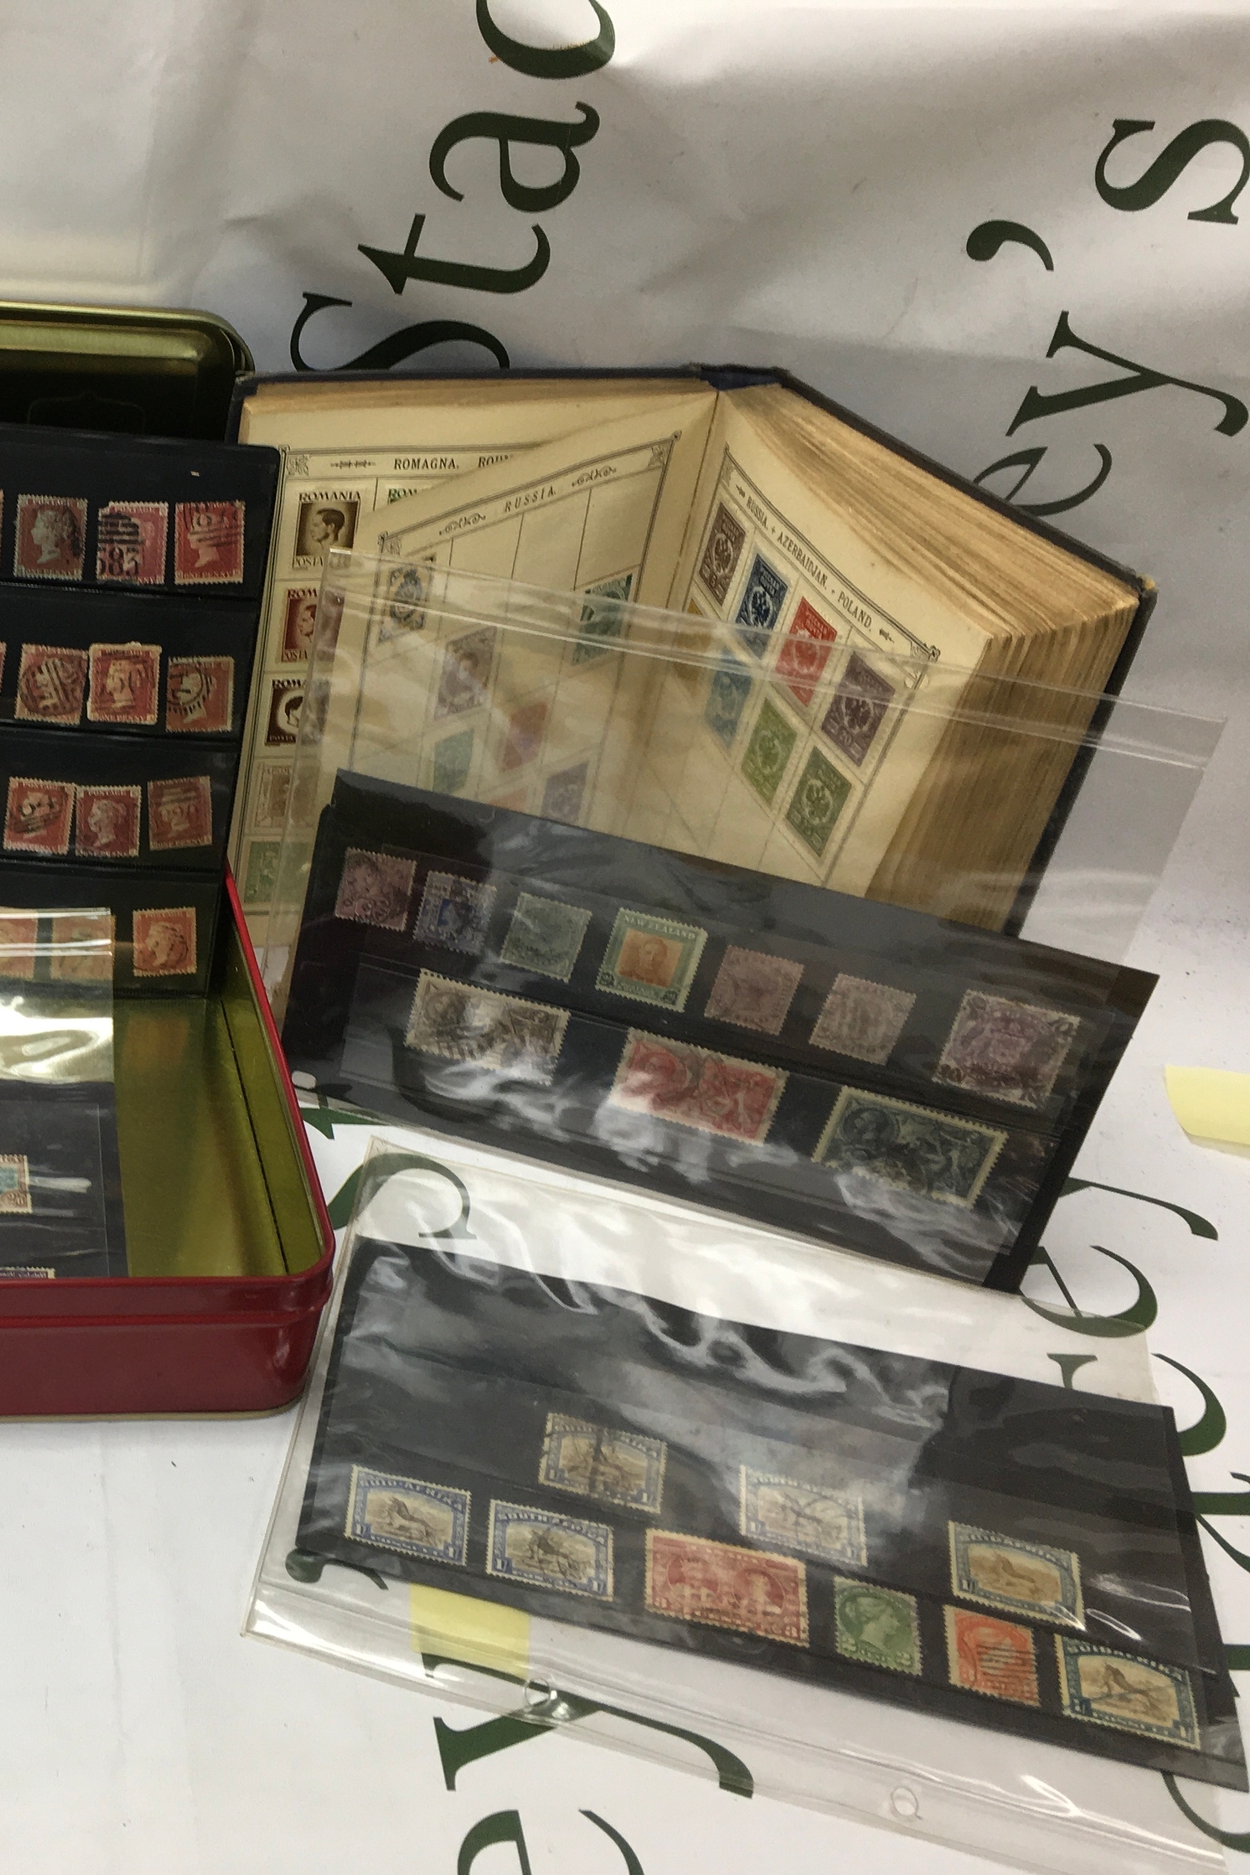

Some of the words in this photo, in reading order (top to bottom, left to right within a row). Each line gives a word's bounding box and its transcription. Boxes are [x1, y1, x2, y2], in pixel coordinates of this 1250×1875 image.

[393, 457, 460, 471] ROMAGNA.
[298, 490, 362, 502] ROMANIA
[504, 485, 557, 513] RUSSIA.
[837, 592, 873, 633] POLAND.
